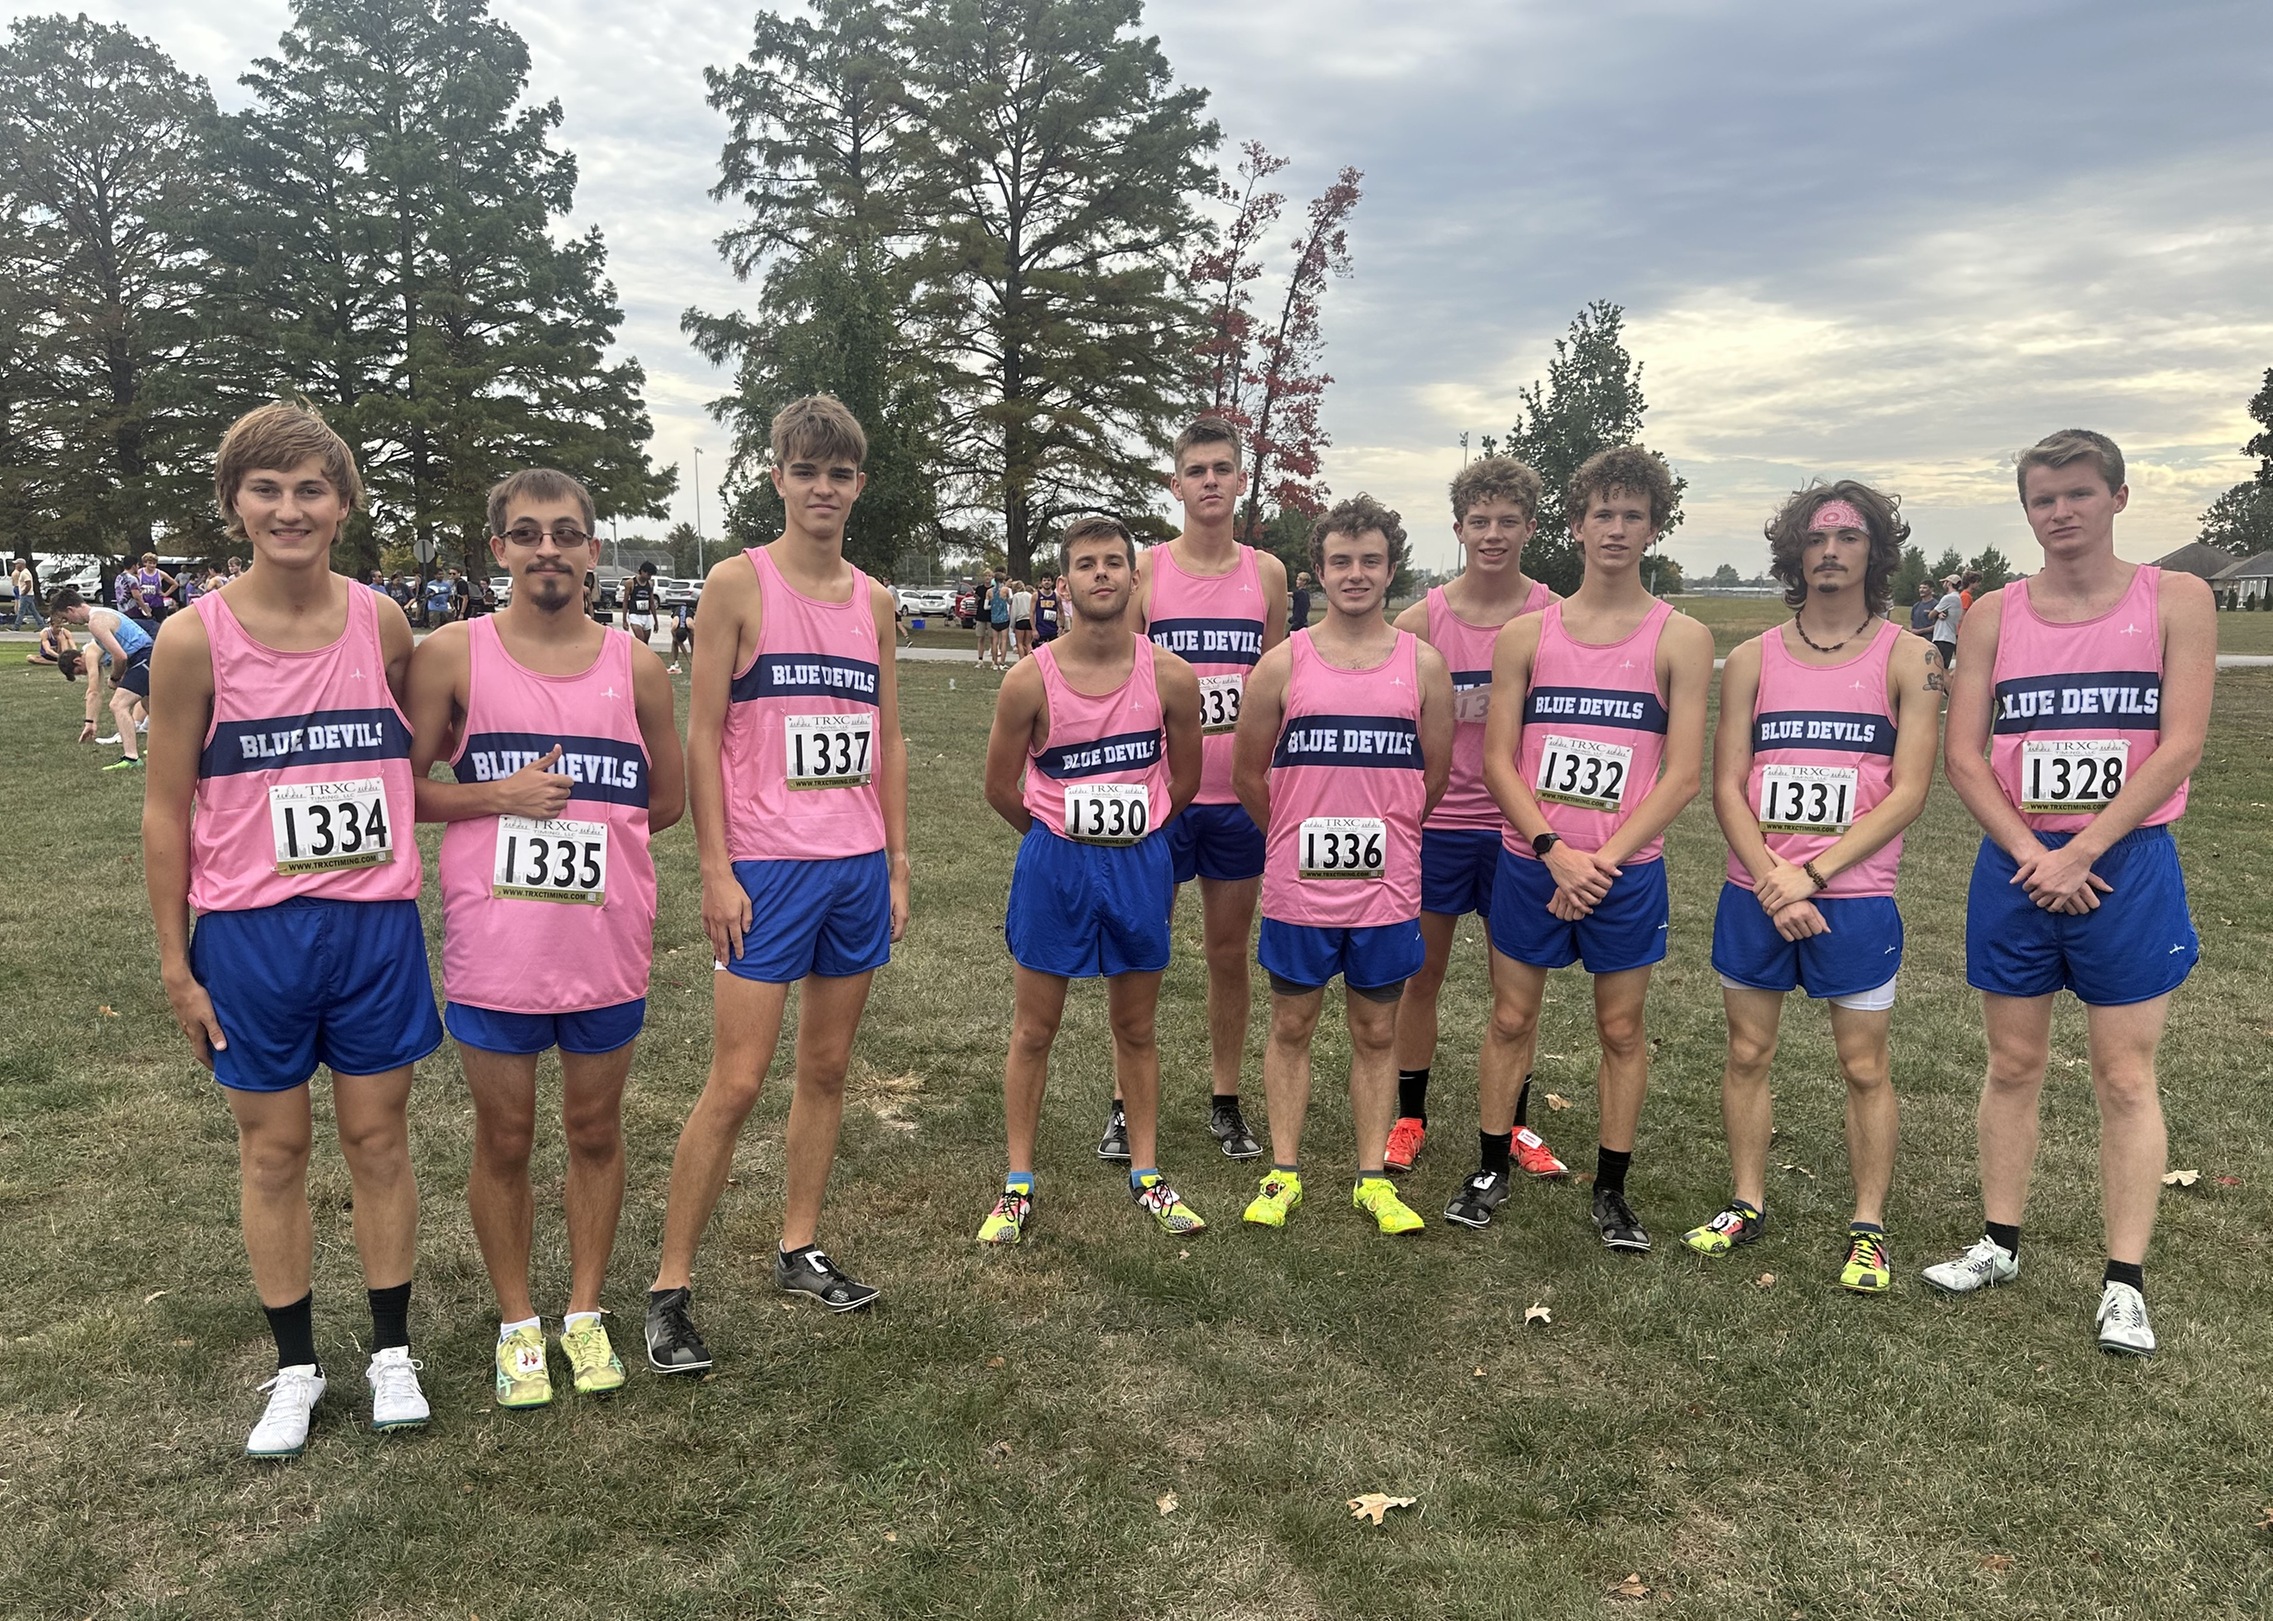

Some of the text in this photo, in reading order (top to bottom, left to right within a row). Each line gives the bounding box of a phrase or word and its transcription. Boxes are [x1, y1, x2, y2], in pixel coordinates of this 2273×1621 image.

[771, 665, 875, 693] BLUE DEVILS
[1200, 677, 1221, 685] RXC
[1200, 688, 1240, 725] 333
[1535, 697, 1644, 720] BLUE DEVILS
[1999, 687, 2159, 720] LUE DEVILS
[812, 716, 850, 725] TRXC
[1761, 720, 1876, 743] BLUE DEVILS
[239, 729, 304, 759] BLUE
[795, 731, 870, 776] 1337
[1287, 728, 1416, 755] BLUE DEVILS
[1569, 740, 1607, 752] TRXC
[2052, 741, 2099, 751] TRXC
[1062, 740, 1155, 771] BLUE DEVILS
[1545, 752, 1623, 800] 1332
[1789, 767, 1830, 777] TRXC
[2032, 757, 2122, 800] 1328
[305, 782, 357, 796] TRXC
[1089, 785, 1123, 793] TRXC
[1769, 781, 1846, 823] 1331
[284, 798, 387, 858] 1334
[531, 819, 579, 832] TRXC
[1073, 799, 1146, 836] 1330
[1324, 819, 1361, 827] TRXC
[1766, 824, 1835, 833] WWW.TRXCTIMING.COM
[288, 855, 376, 871] WWW.TRXCTIMING.COM
[505, 836, 601, 889] 1335
[1308, 833, 1382, 869] 1336
[503, 889, 586, 900] WWW.TRXCTIMING.COM
